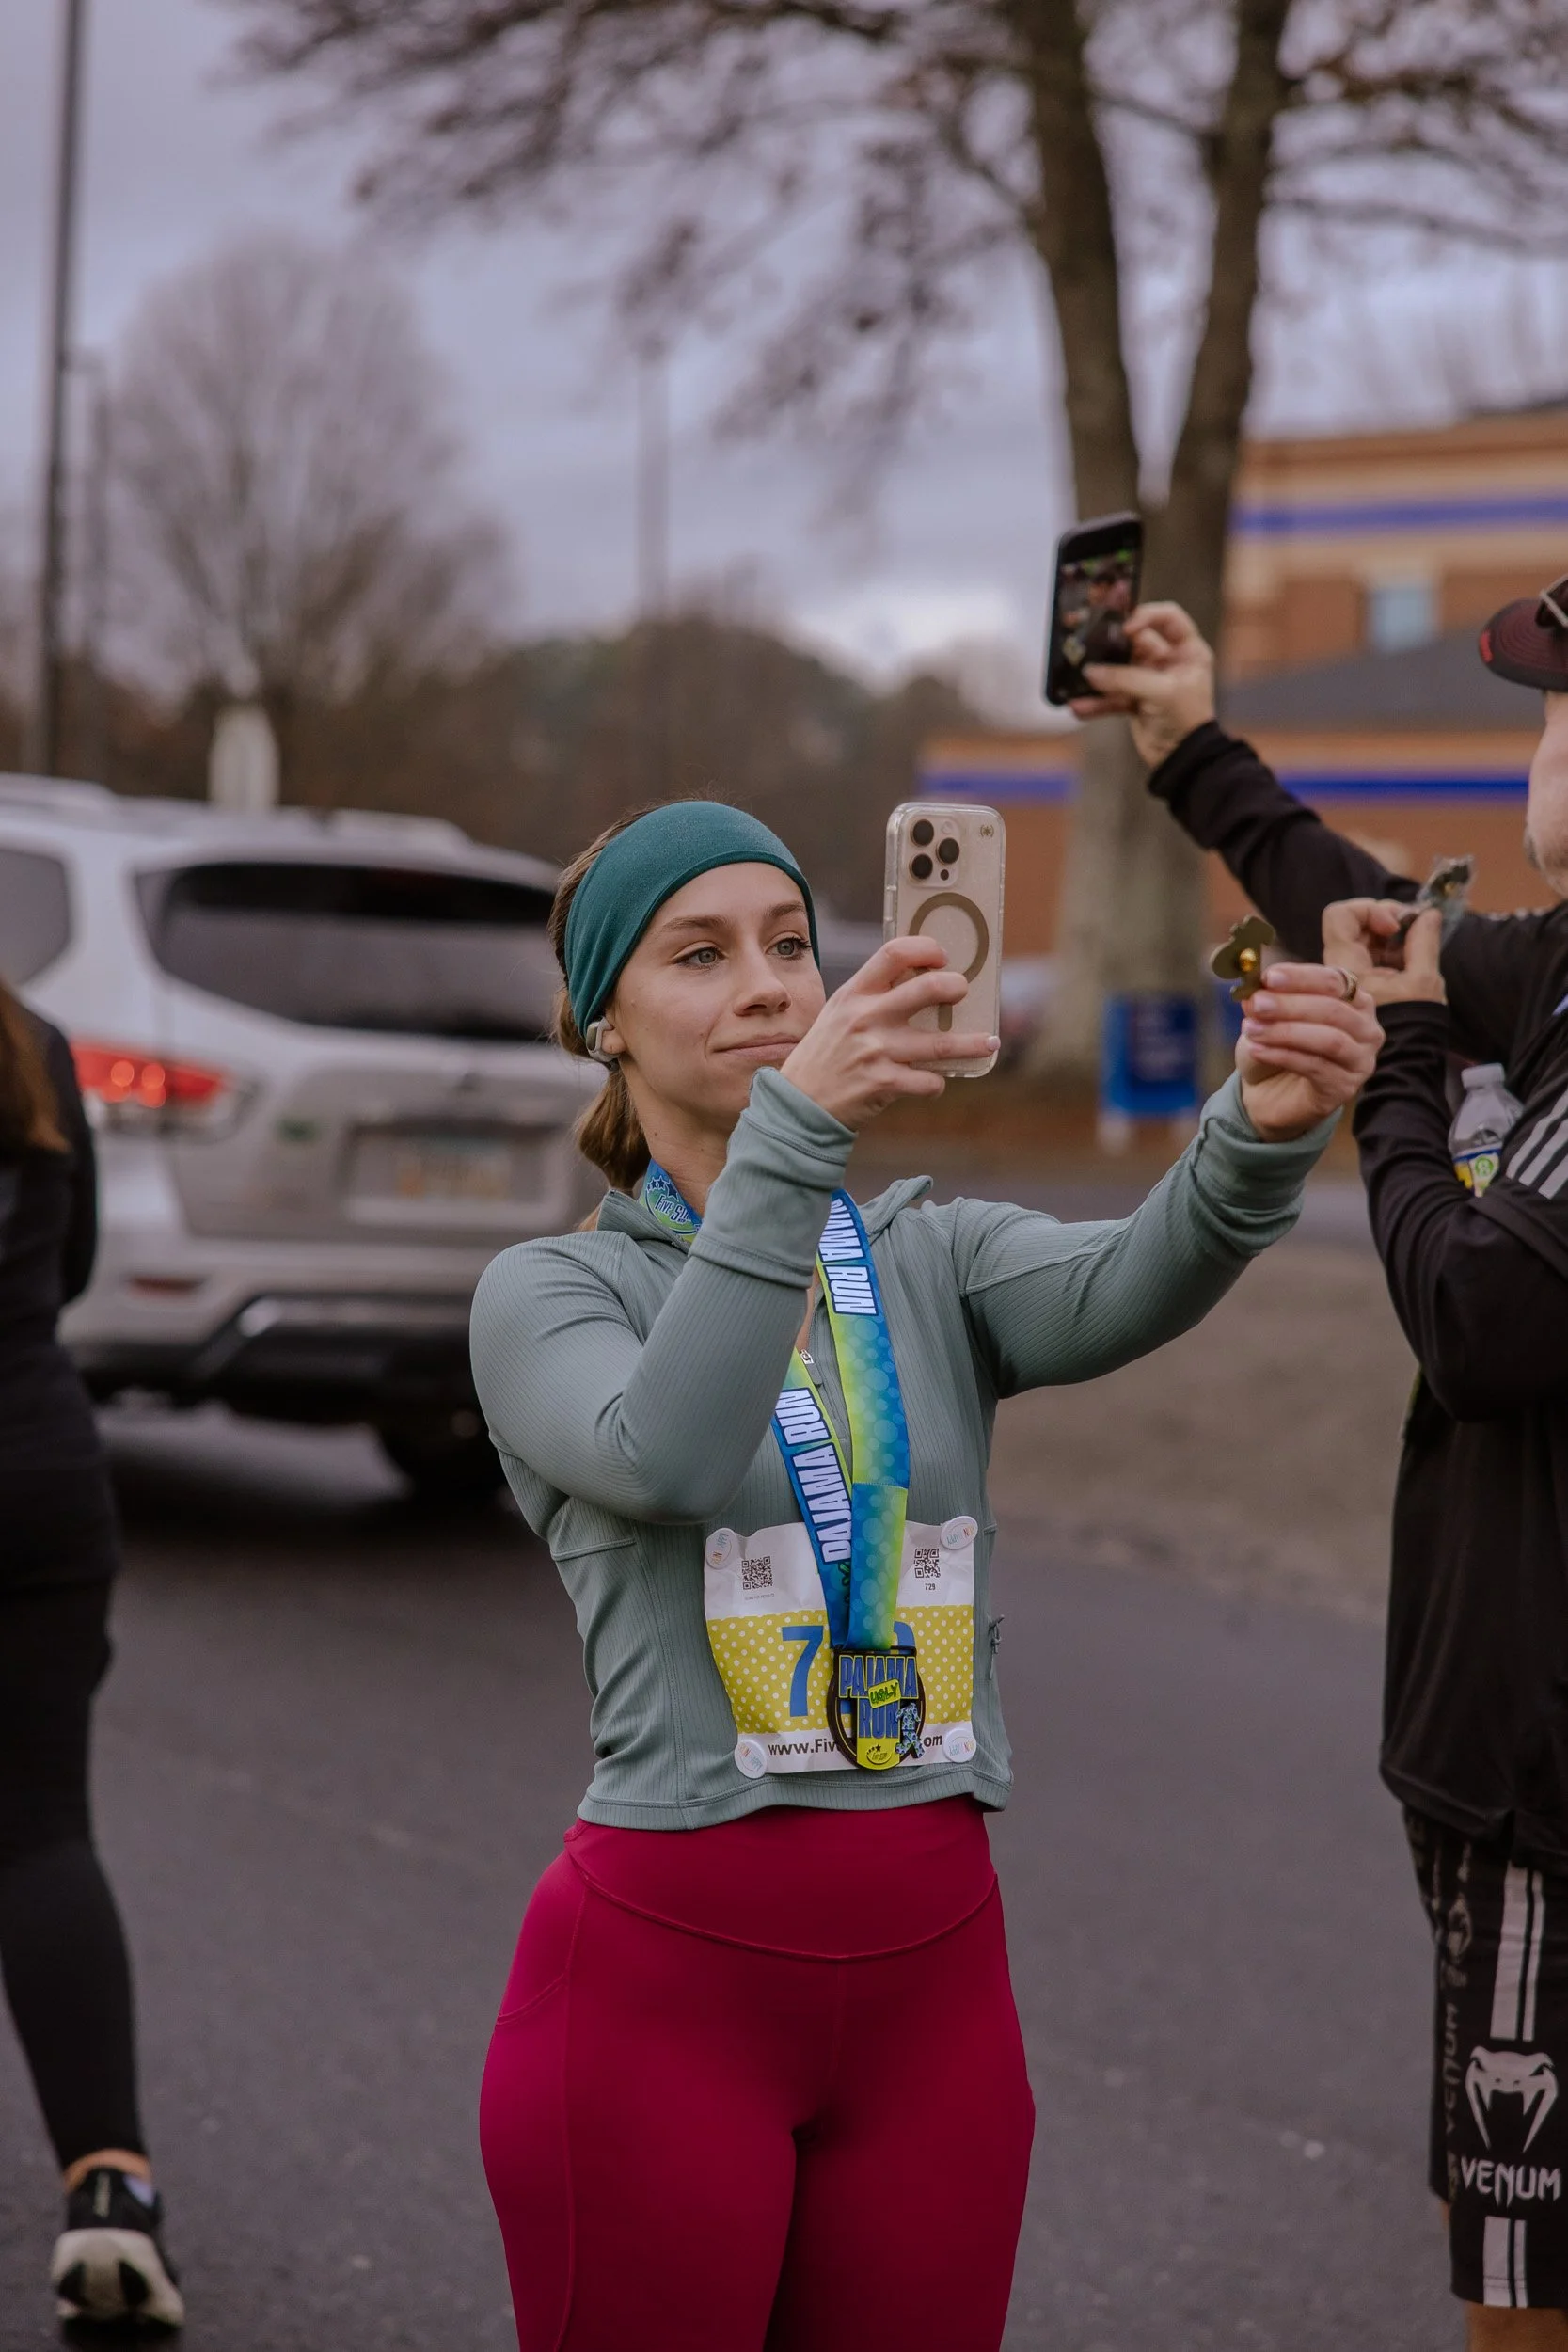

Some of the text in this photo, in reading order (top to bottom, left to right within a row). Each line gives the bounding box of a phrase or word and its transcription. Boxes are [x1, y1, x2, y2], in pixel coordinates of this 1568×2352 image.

[824, 1266, 877, 1315] RUN
[775, 1388, 832, 1445] RUN
[793, 1445, 851, 1563] PAJAMA
[924, 1582, 936, 1591] 729
[869, 1681, 900, 1705] UGLY
[858, 1696, 899, 1740] RUN
[1461, 2155, 1561, 2208] VENUM
